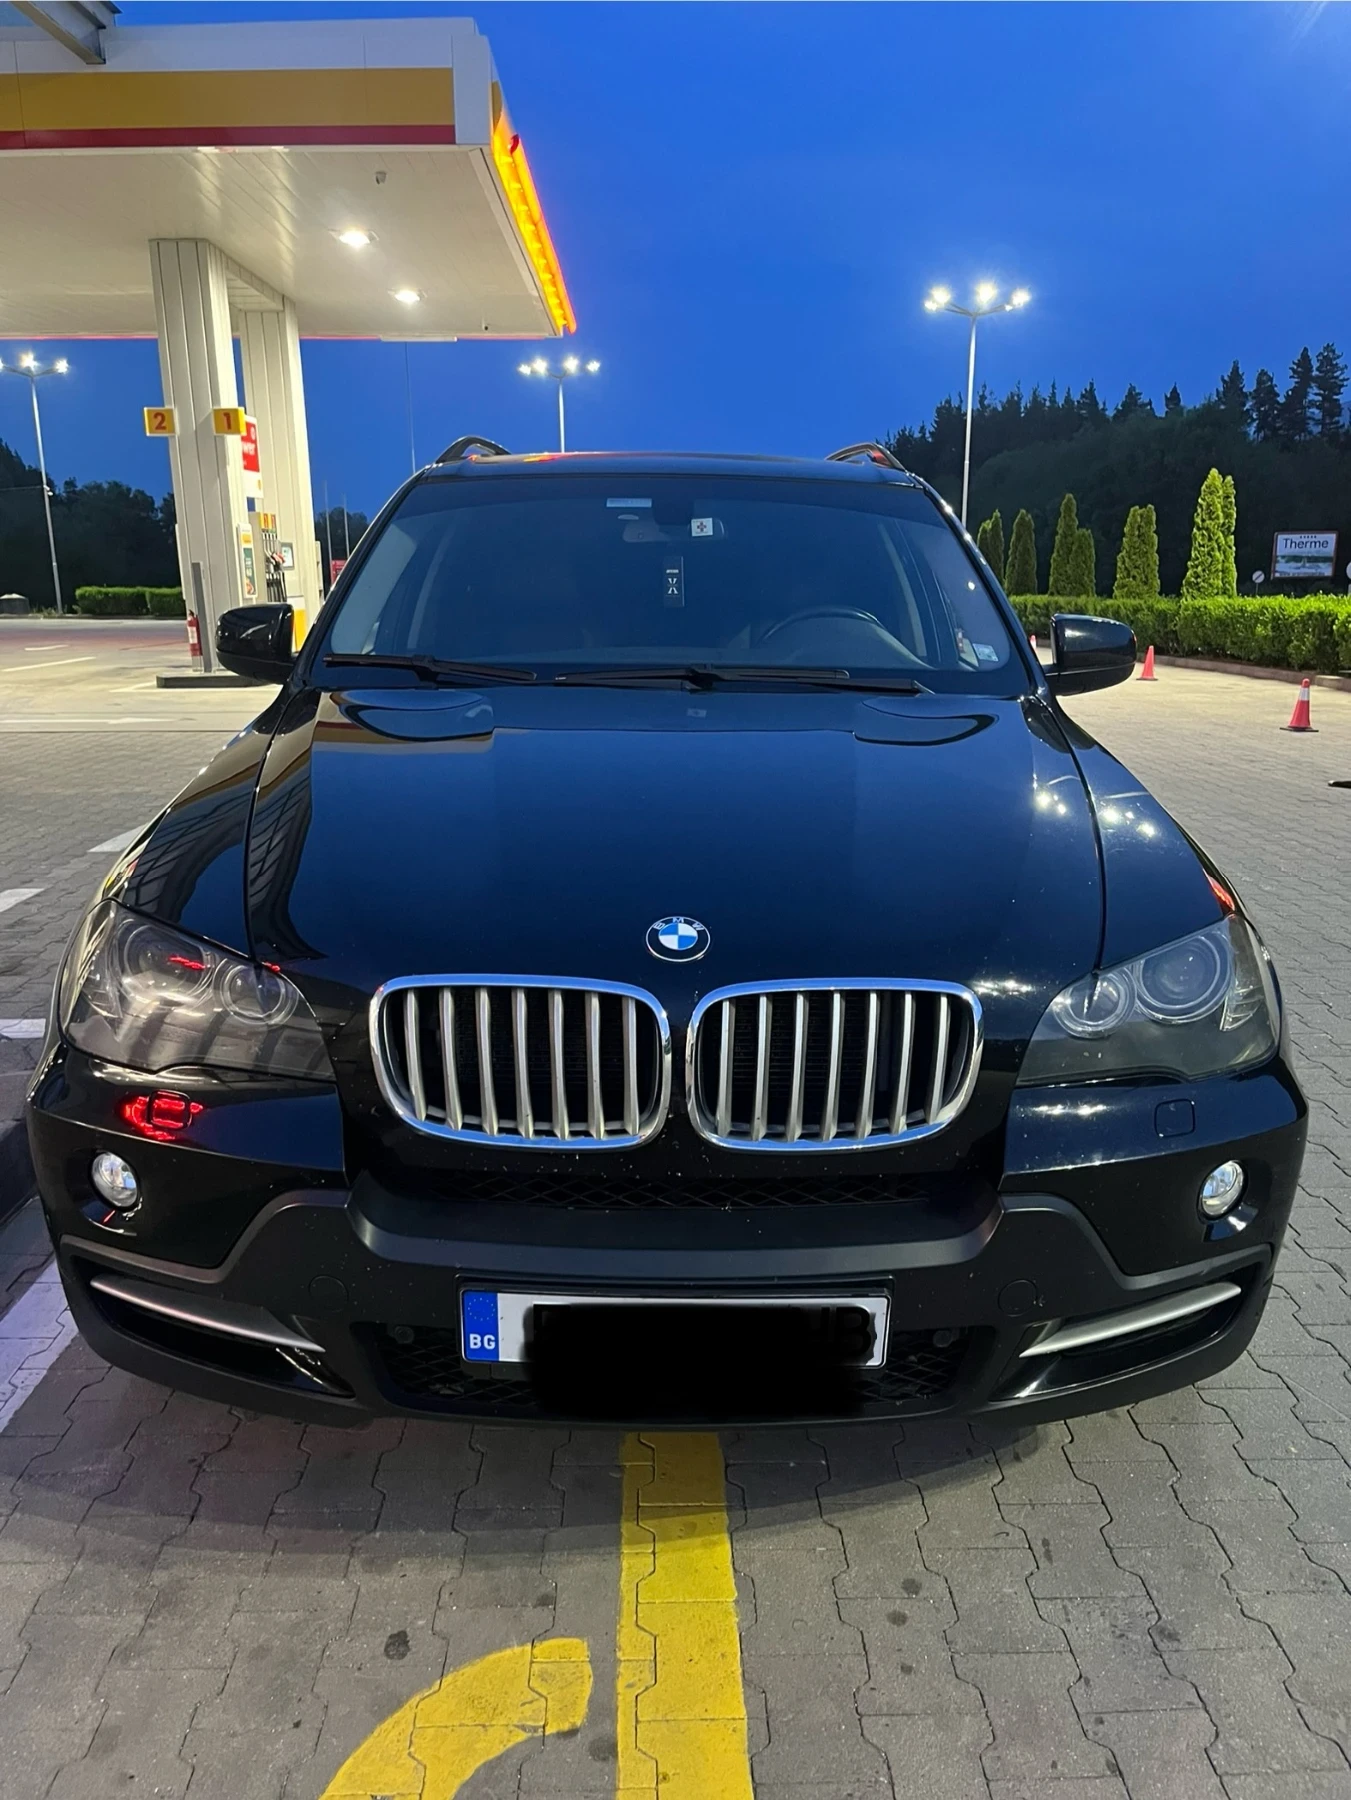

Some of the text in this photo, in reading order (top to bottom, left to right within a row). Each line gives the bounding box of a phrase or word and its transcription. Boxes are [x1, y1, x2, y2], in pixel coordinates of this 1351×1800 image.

[153, 412, 167, 431] 2
[223, 412, 232, 430] 1
[1283, 537, 1329, 549] Therme
[653, 917, 705, 931] BMW
[469, 1333, 496, 1350] BG
